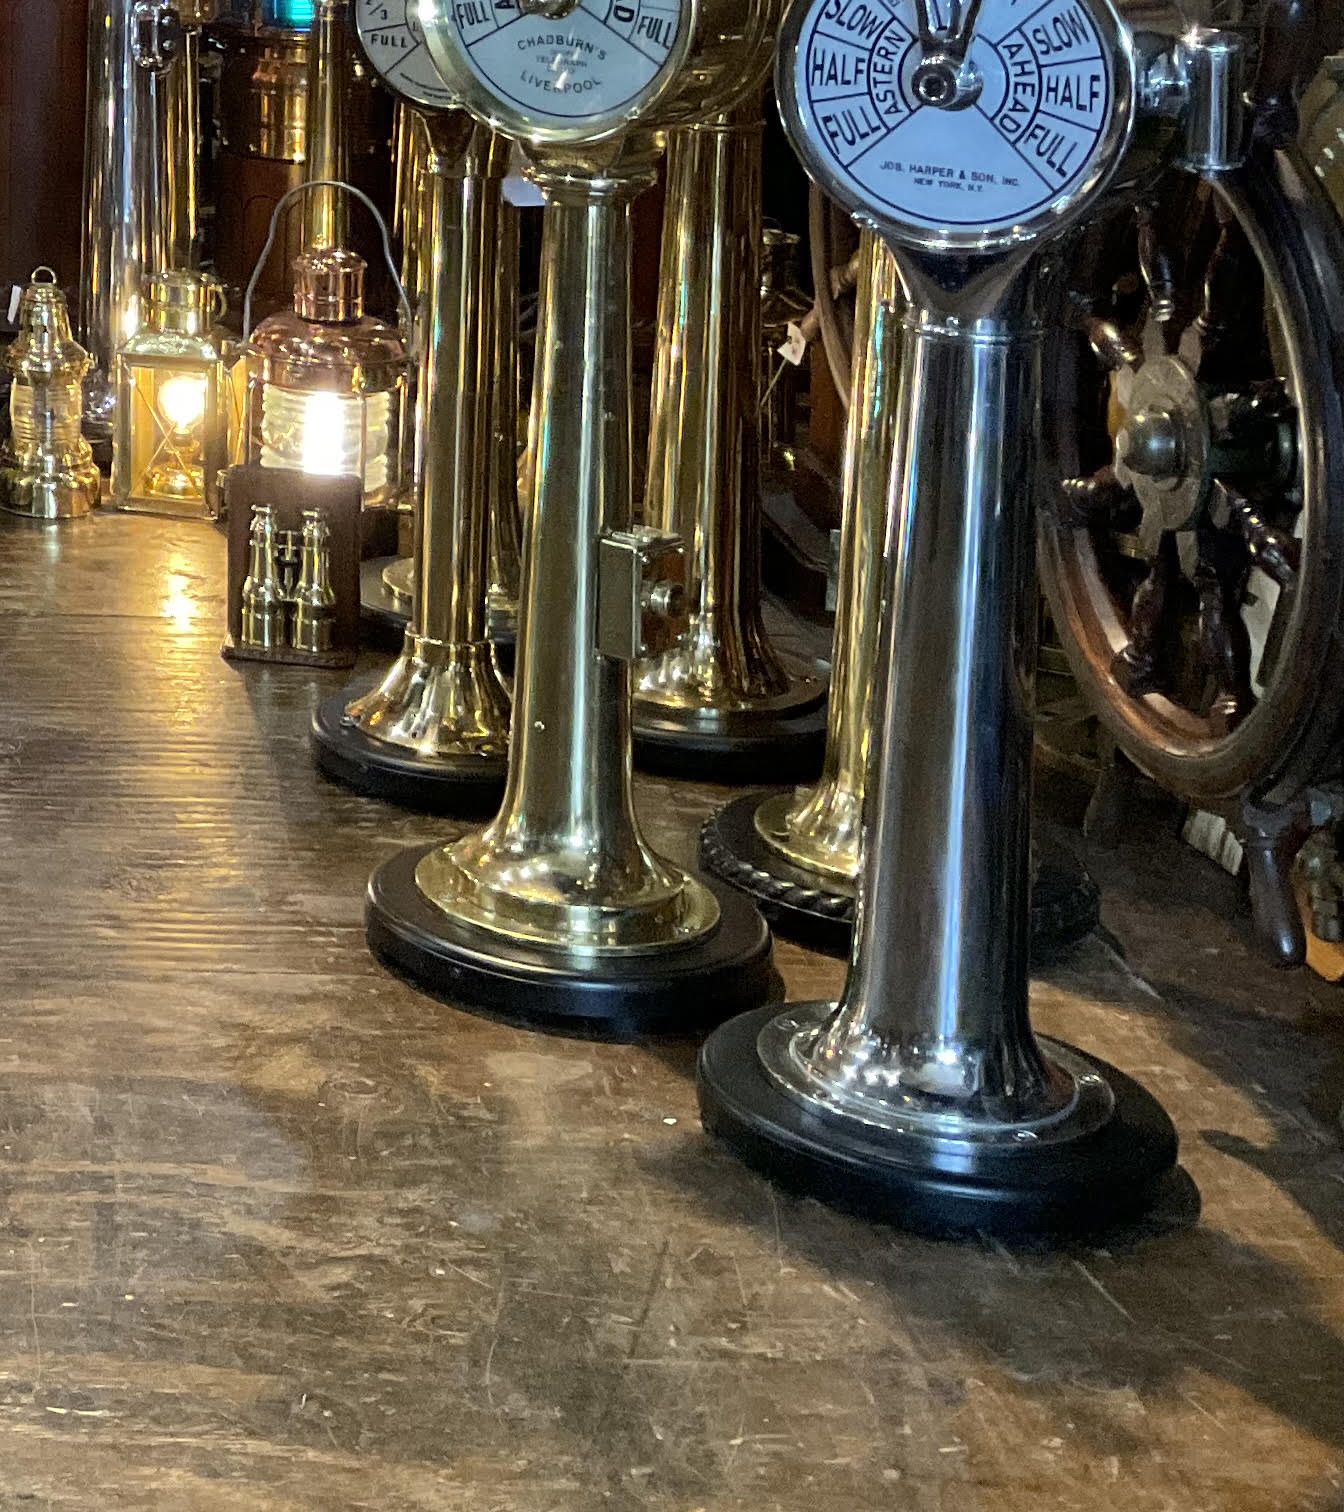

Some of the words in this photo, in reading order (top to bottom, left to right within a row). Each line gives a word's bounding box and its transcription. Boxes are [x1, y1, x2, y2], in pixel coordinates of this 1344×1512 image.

[457, 0, 491, 31] FULL
[637, 17, 676, 51] FULL
[1032, 4, 1089, 56] SLOW
[370, 33, 410, 50] FULL
[812, 48, 867, 88] HALF
[870, 29, 906, 116] ASTERN
[1001, 42, 1035, 136] AHEAD
[1046, 75, 1101, 113] HALF
[823, 106, 881, 156] FULL
[1025, 124, 1079, 178] FULL
[909, 163, 955, 179] HARPER
